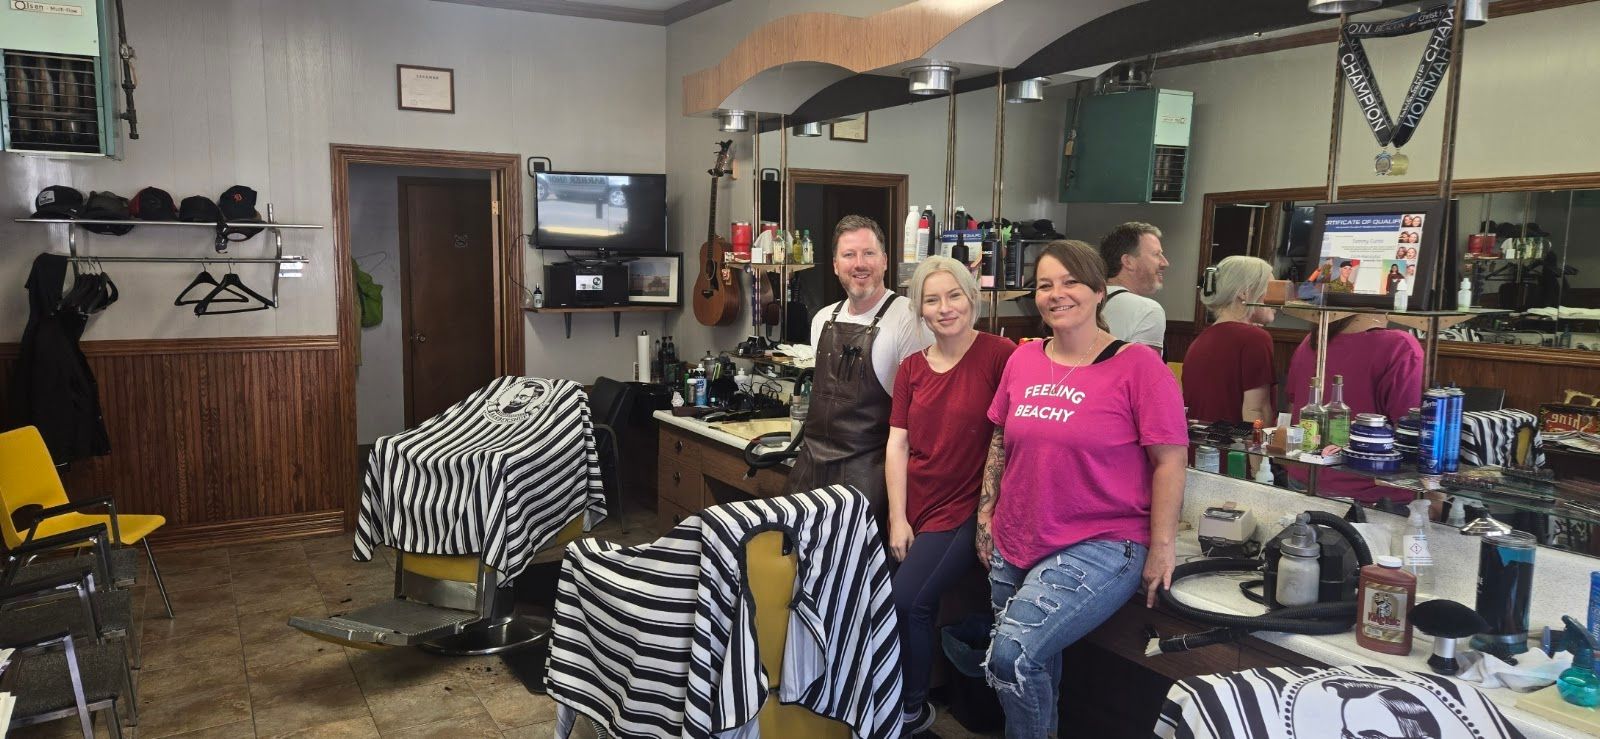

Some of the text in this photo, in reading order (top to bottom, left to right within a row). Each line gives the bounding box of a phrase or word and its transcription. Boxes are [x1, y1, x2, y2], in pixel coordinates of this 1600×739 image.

[1341, 53, 1387, 132] CHAMPION
[1025, 384, 1086, 404] FEELING
[1015, 405, 1075, 422] BEACHY
